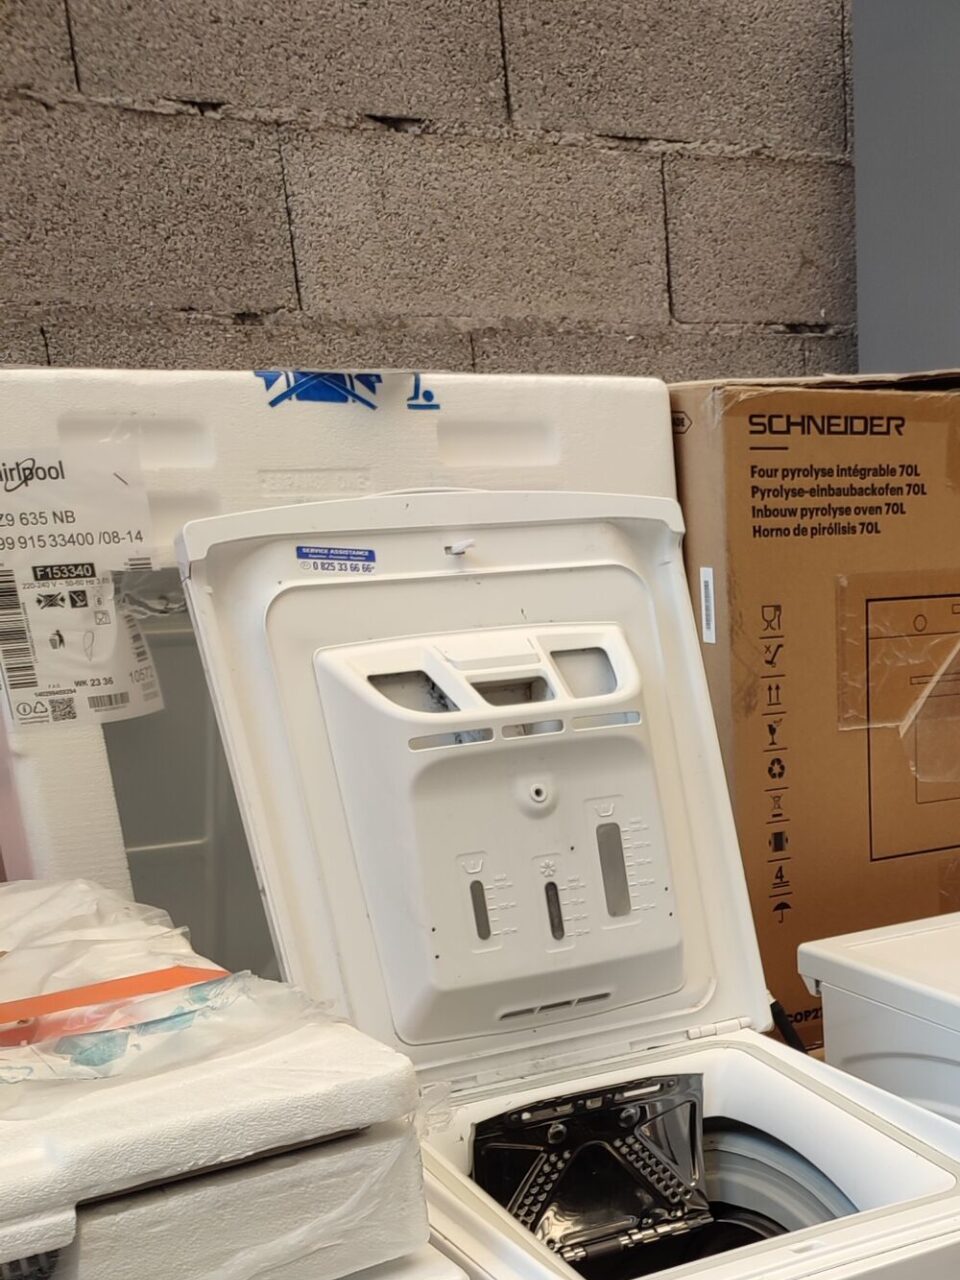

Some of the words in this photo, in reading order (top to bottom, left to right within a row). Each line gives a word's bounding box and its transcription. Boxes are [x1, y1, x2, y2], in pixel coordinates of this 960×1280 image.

[749, 414, 906, 436] SCHNEIDER
[0, 459, 65, 487] irlpool
[750, 465, 779, 478] Four
[781, 464, 834, 480] pyrolyse
[836, 464, 897, 480] intégrable
[898, 464, 921, 477] 70L
[751, 483, 904, 500] Pyrolyse-einbaubackofen
[905, 483, 928, 496] 70L
[19, 511, 48, 526] 635
[52, 510, 76, 524] NB
[752, 505, 798, 518] Inbouw
[800, 503, 852, 519] pyrolyse
[853, 505, 883, 516] oven
[884, 502, 906, 515] 70L
[752, 525, 791, 538] Horno
[793, 523, 808, 536] de
[810, 521, 857, 539] pirólisis
[858, 521, 881, 534] 70L
[36, 565, 92, 579] F153340
